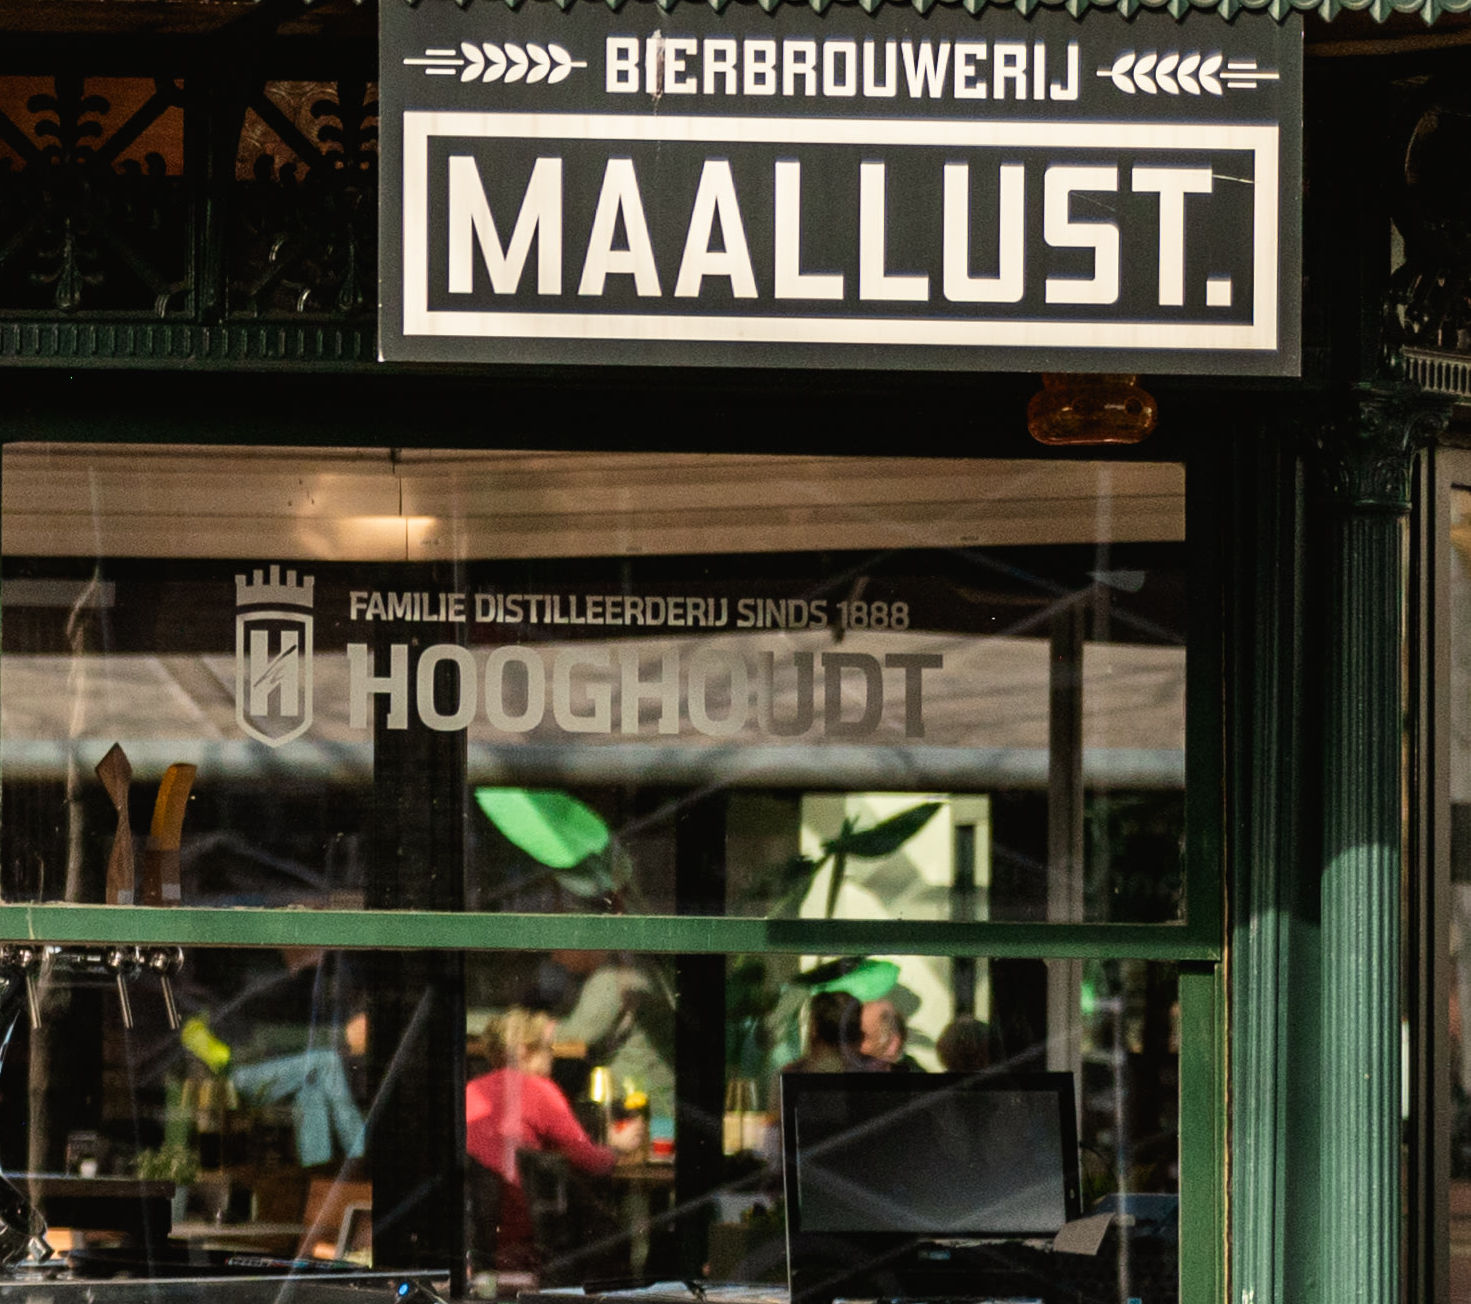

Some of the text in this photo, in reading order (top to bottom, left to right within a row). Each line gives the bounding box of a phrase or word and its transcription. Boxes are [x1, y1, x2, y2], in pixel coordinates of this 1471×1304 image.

[604, 36, 1080, 102] BIERBROUWERIJ
[447, 154, 1234, 308] MAALLUST.
[348, 591, 911, 632] FAMILIE DISTILLEERDERIJ SINDS 1888
[345, 641, 945, 740] HOOGHOUDT
